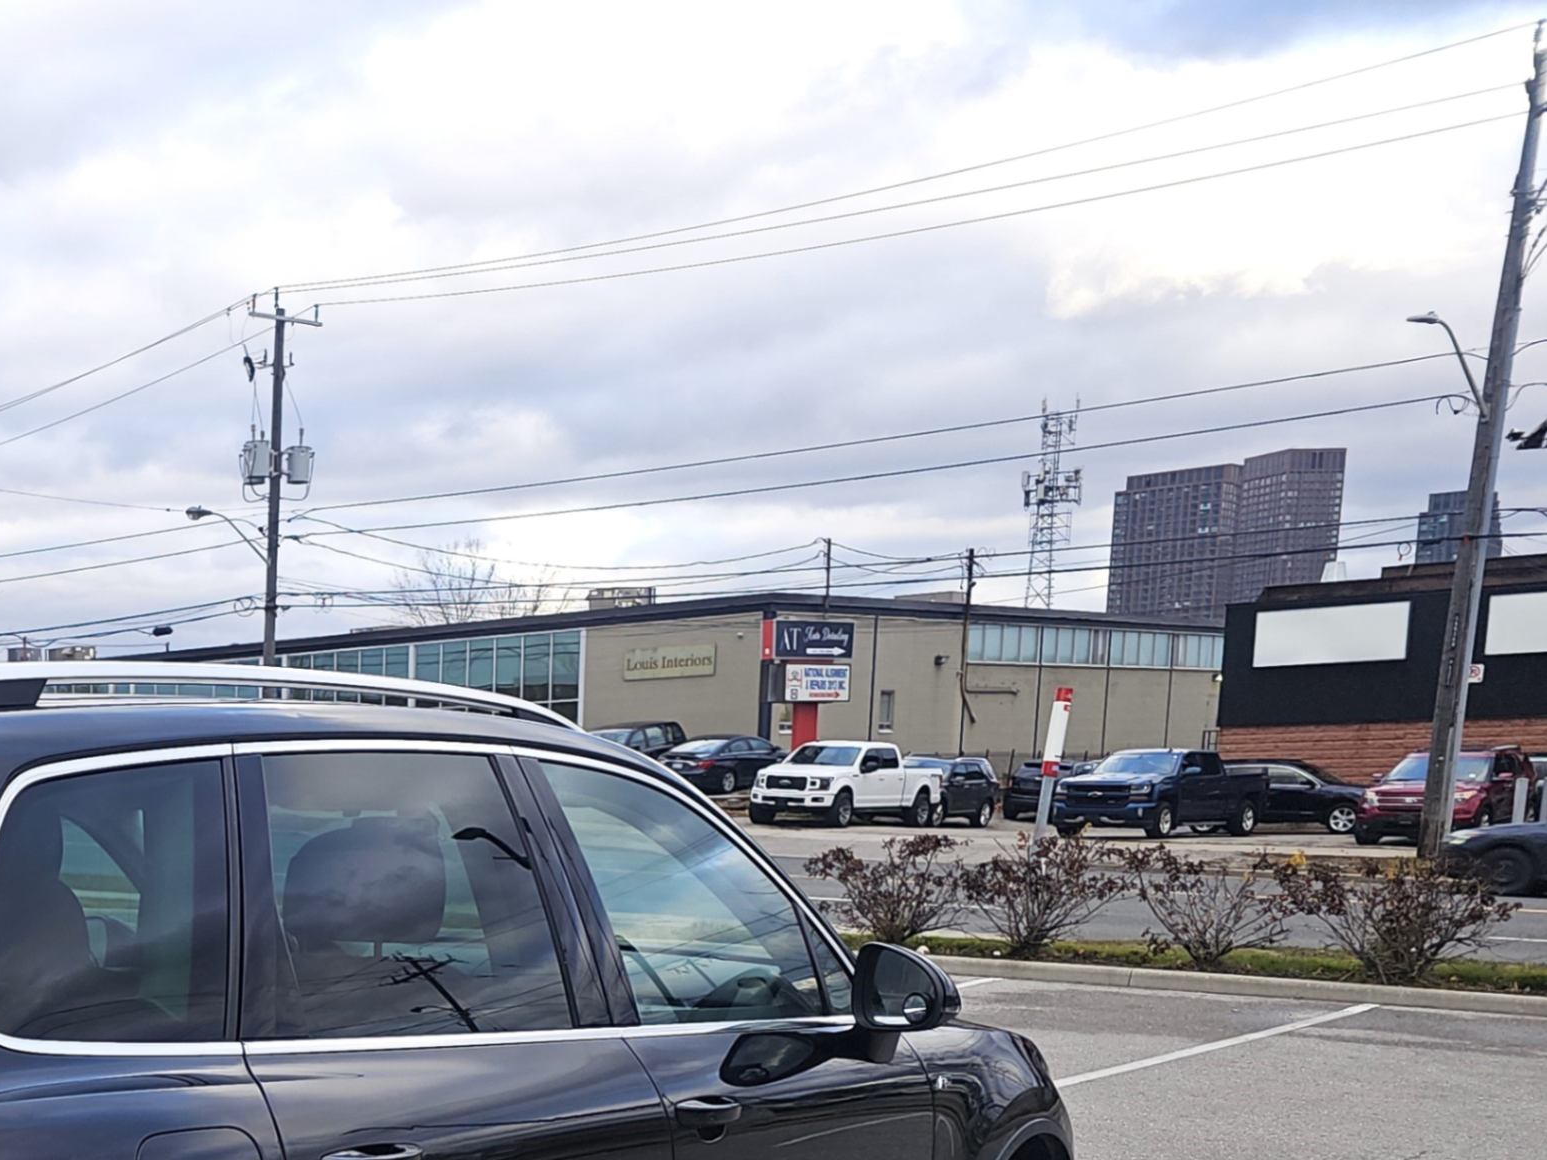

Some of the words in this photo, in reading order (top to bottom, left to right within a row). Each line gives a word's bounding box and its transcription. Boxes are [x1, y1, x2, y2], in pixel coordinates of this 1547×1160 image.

[780, 627, 802, 651] AT
[626, 655, 659, 671] Louis
[661, 653, 713, 669] Interiors
